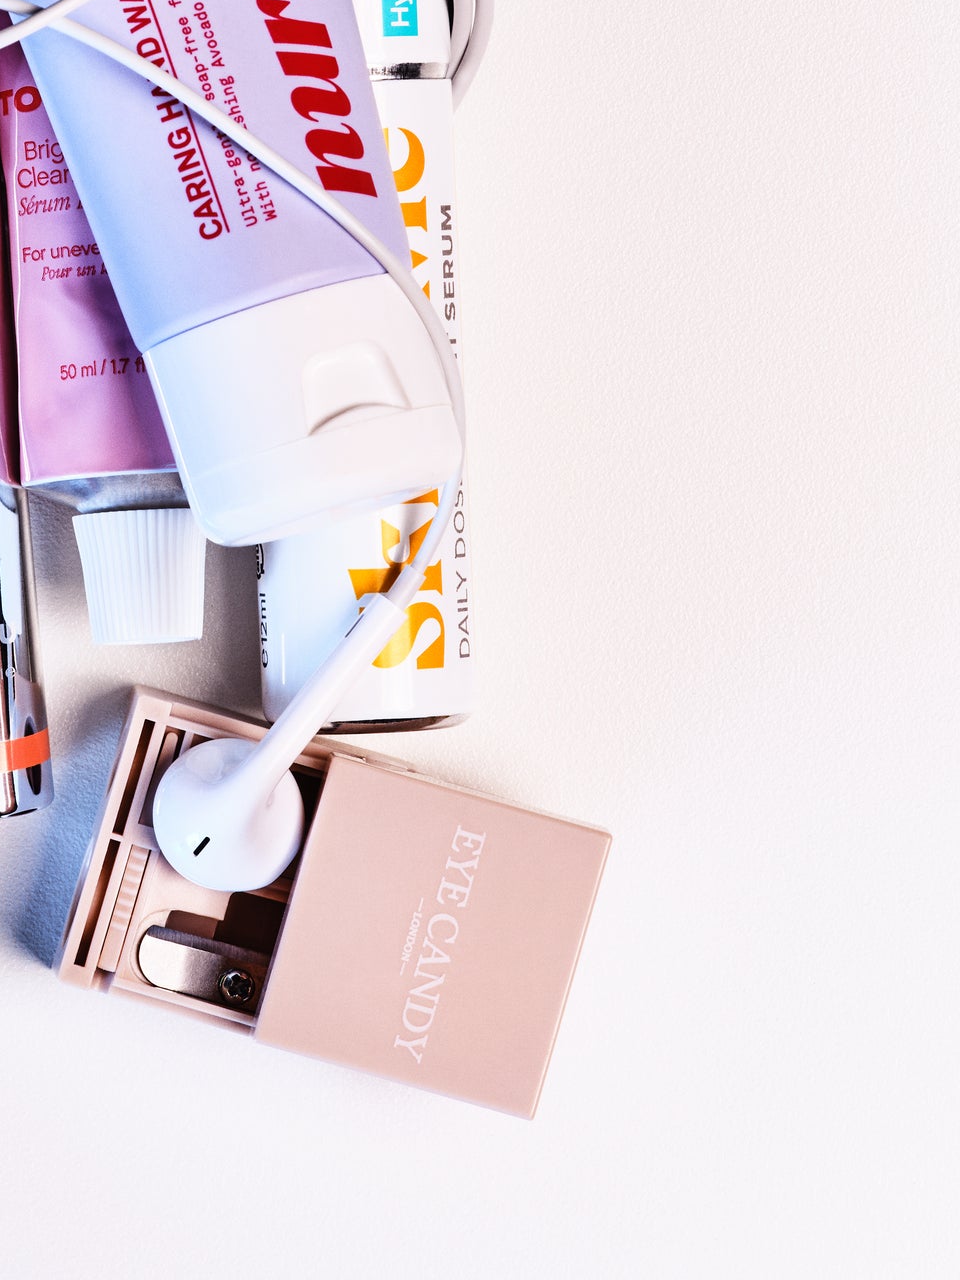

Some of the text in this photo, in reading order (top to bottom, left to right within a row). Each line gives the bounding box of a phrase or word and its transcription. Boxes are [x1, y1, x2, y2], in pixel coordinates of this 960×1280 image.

[177, 16, 217, 102] soap-free
[193, 1, 226, 68] Avocado
[17, 166, 74, 191] Clear
[167, 128, 225, 241] CARING
[211, 122, 258, 228] Ultra-gent
[257, 180, 278, 222] With
[18, 194, 72, 217] Sérum
[22, 246, 46, 263] For
[40, 265, 73, 282] Pour
[76, 263, 97, 278] un
[441, 205, 456, 321] SERUM
[59, 364, 77, 381] 50
[81, 360, 98, 378] ml
[101, 358, 107, 376] /
[110, 357, 130, 376] 1.7
[456, 568, 470, 659] DAILY
[393, 824, 486, 1065] EYE CANDY
[400, 911, 423, 962] LONDON
